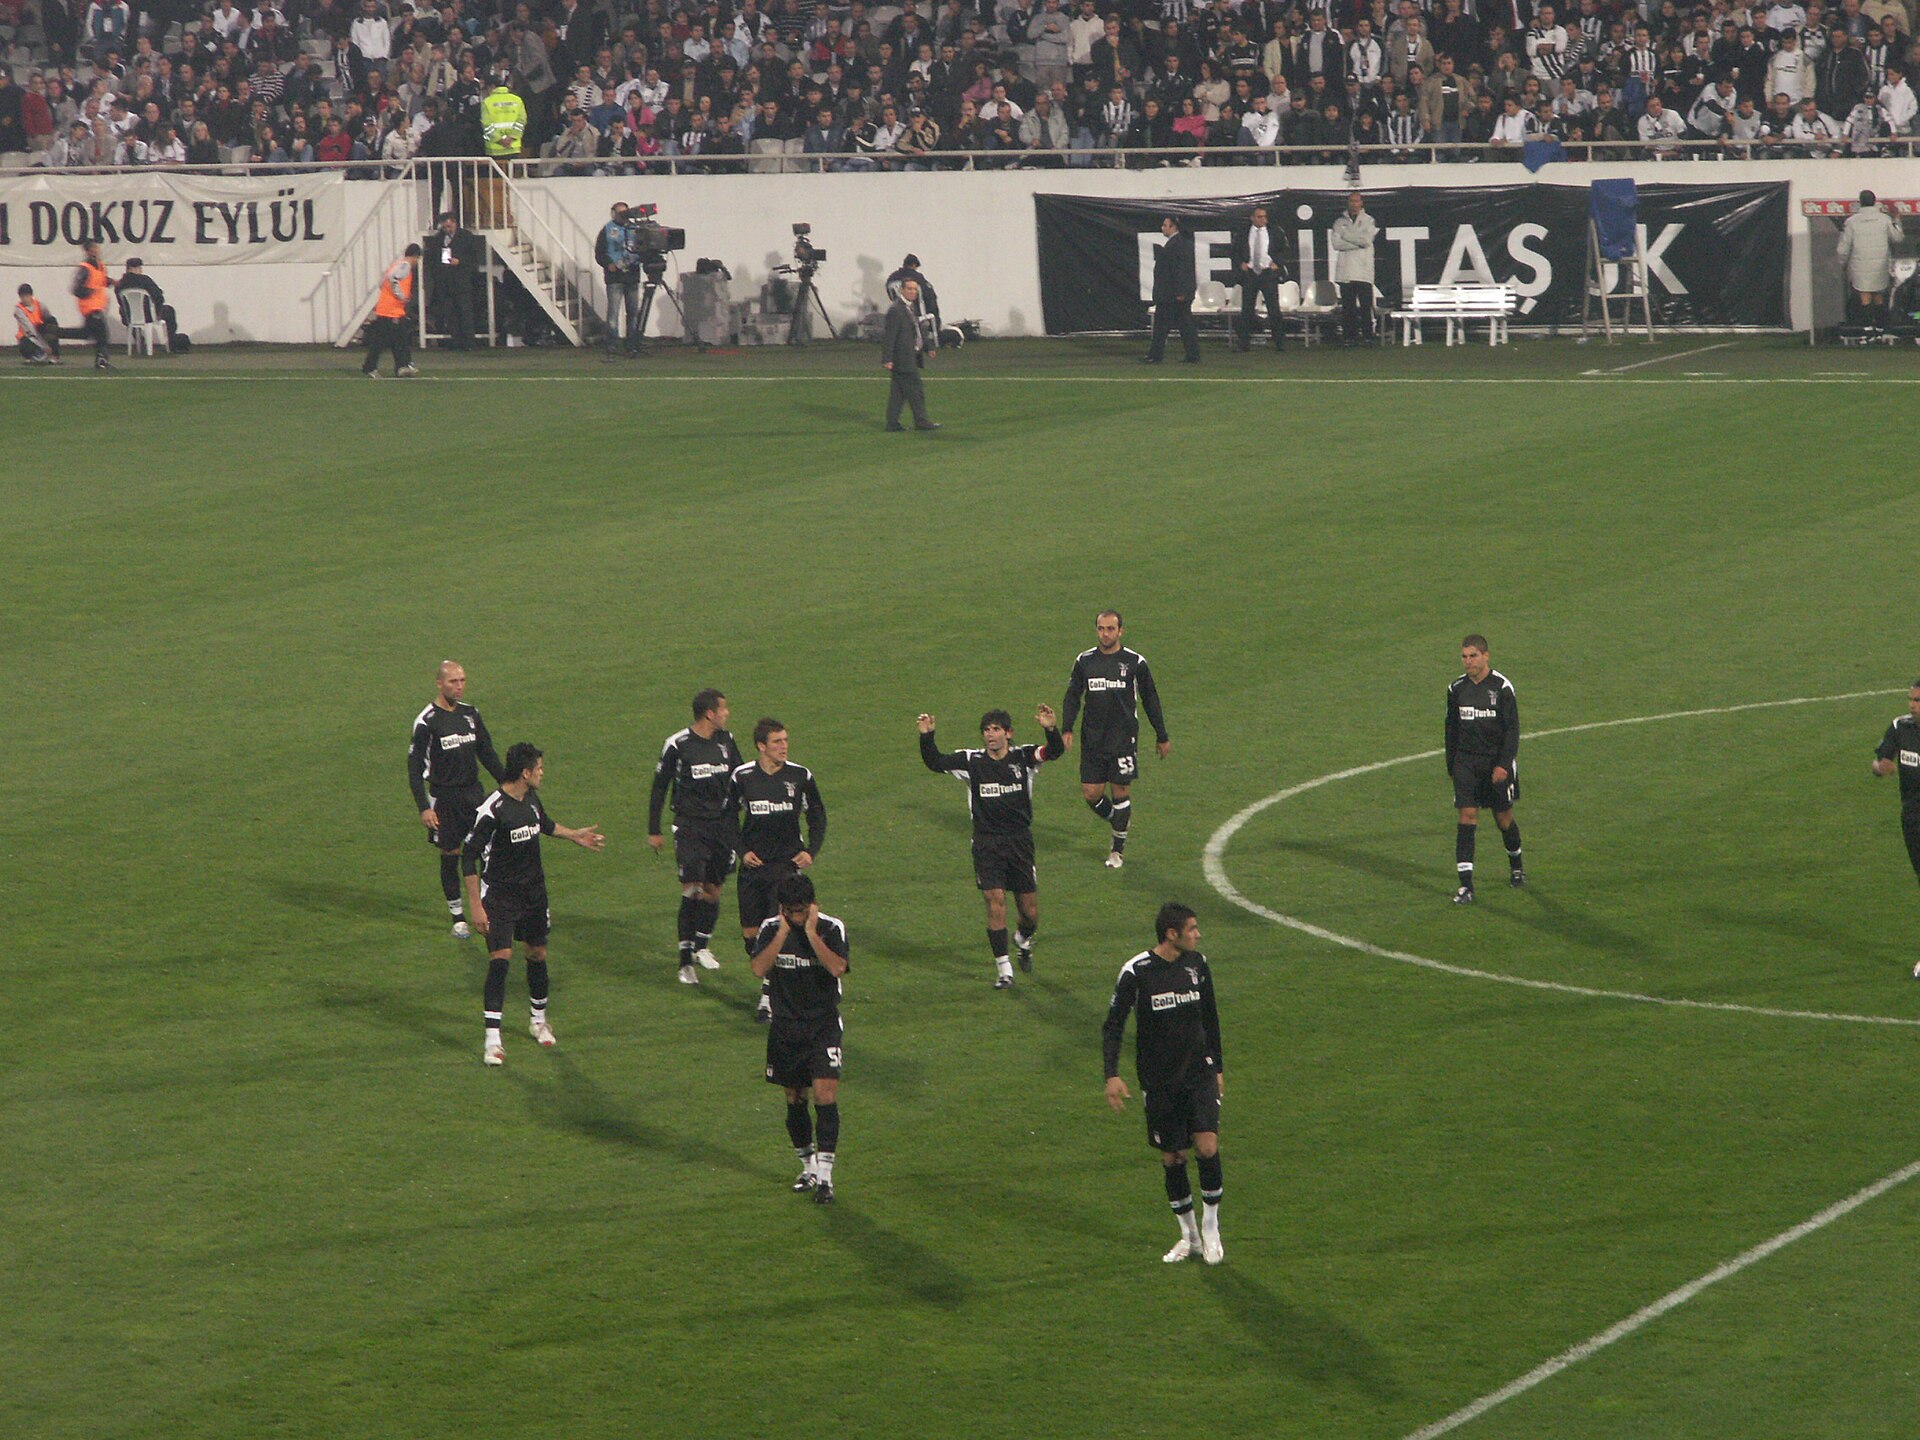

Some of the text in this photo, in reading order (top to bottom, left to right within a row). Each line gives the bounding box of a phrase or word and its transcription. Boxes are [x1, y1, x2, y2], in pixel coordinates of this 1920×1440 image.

[29, 199, 175, 245] DOKUZ
[193, 188, 324, 244] EYLÜL
[1118, 756, 1134, 774] 53
